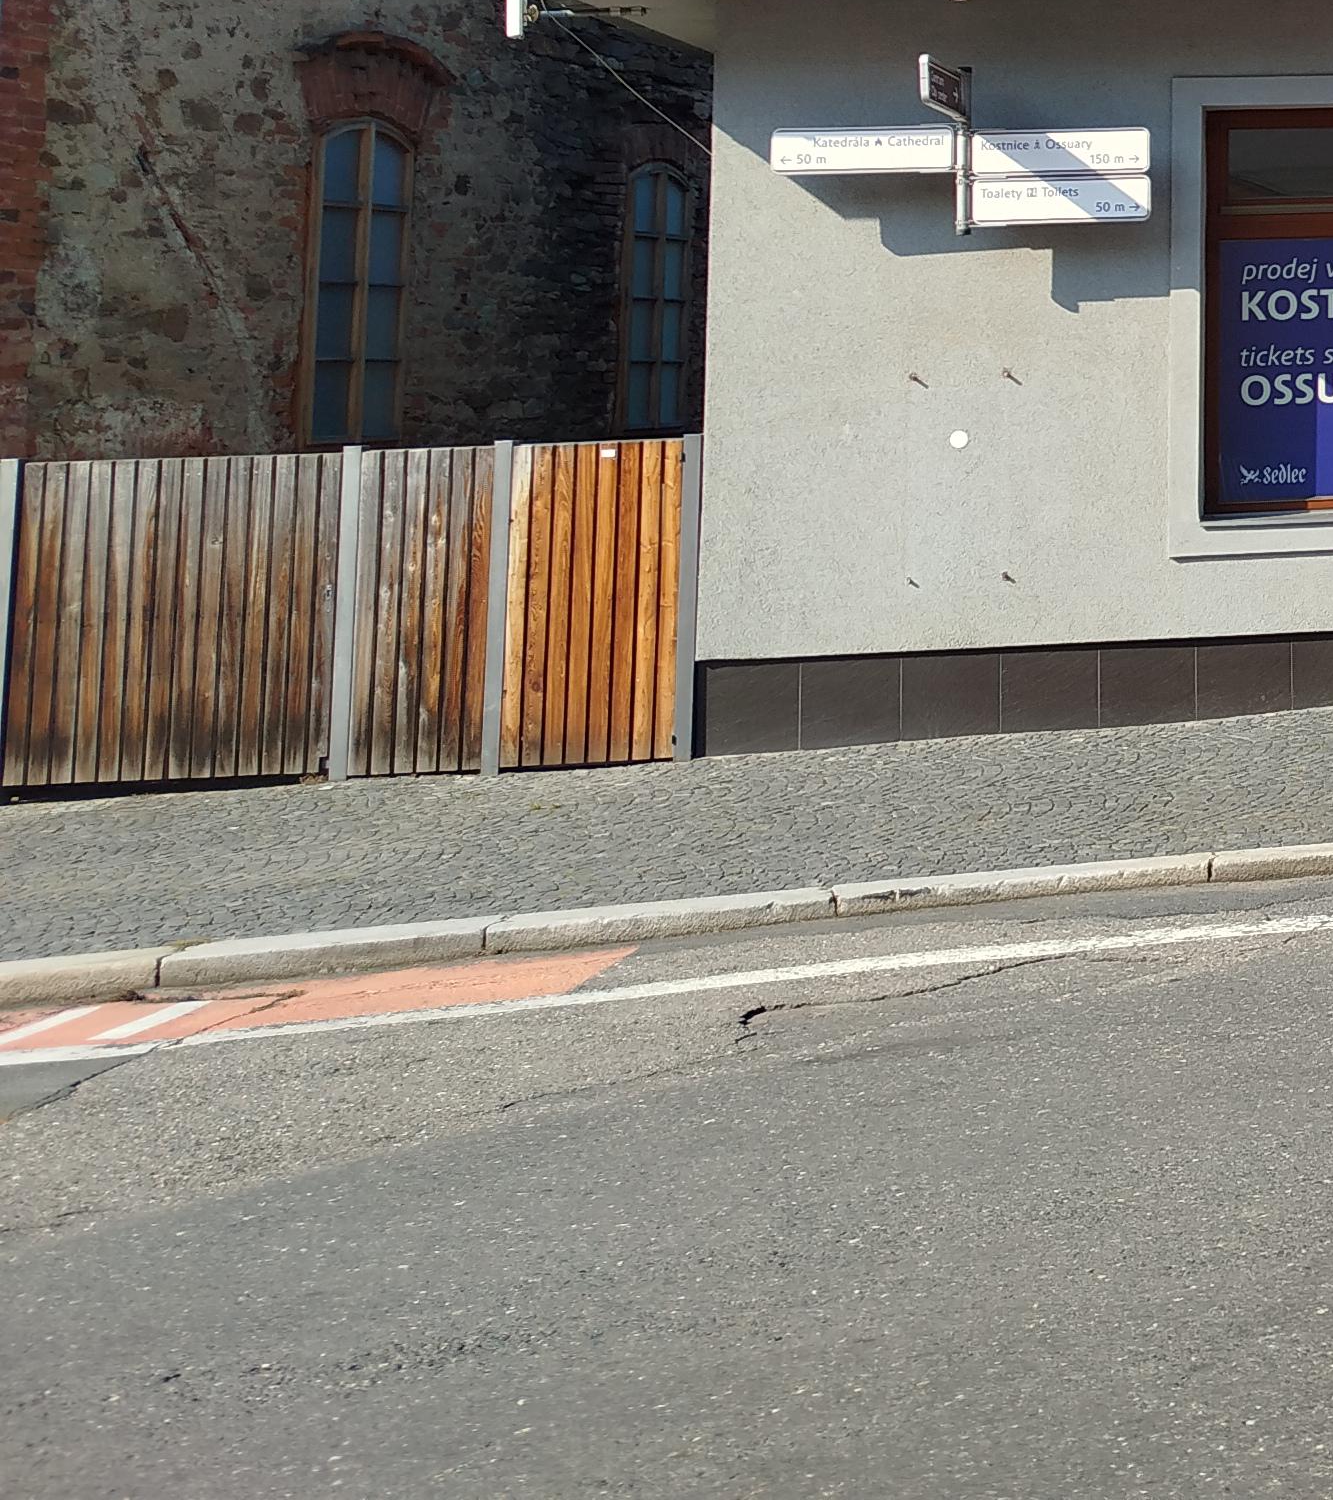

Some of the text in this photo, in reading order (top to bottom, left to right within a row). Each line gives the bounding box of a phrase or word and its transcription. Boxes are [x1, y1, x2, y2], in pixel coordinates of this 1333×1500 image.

[813, 135, 945, 148] Katedrála Cathedral
[981, 138, 1092, 151] Kostnice Ossuary
[796, 153, 827, 165] 50 m
[1089, 153, 1125, 165] 150 m
[981, 186, 1080, 200] Toalety Toilets
[1095, 201, 1126, 213] 50 m
[1241, 257, 1319, 285] prodej
[1240, 343, 1315, 367] tickets
